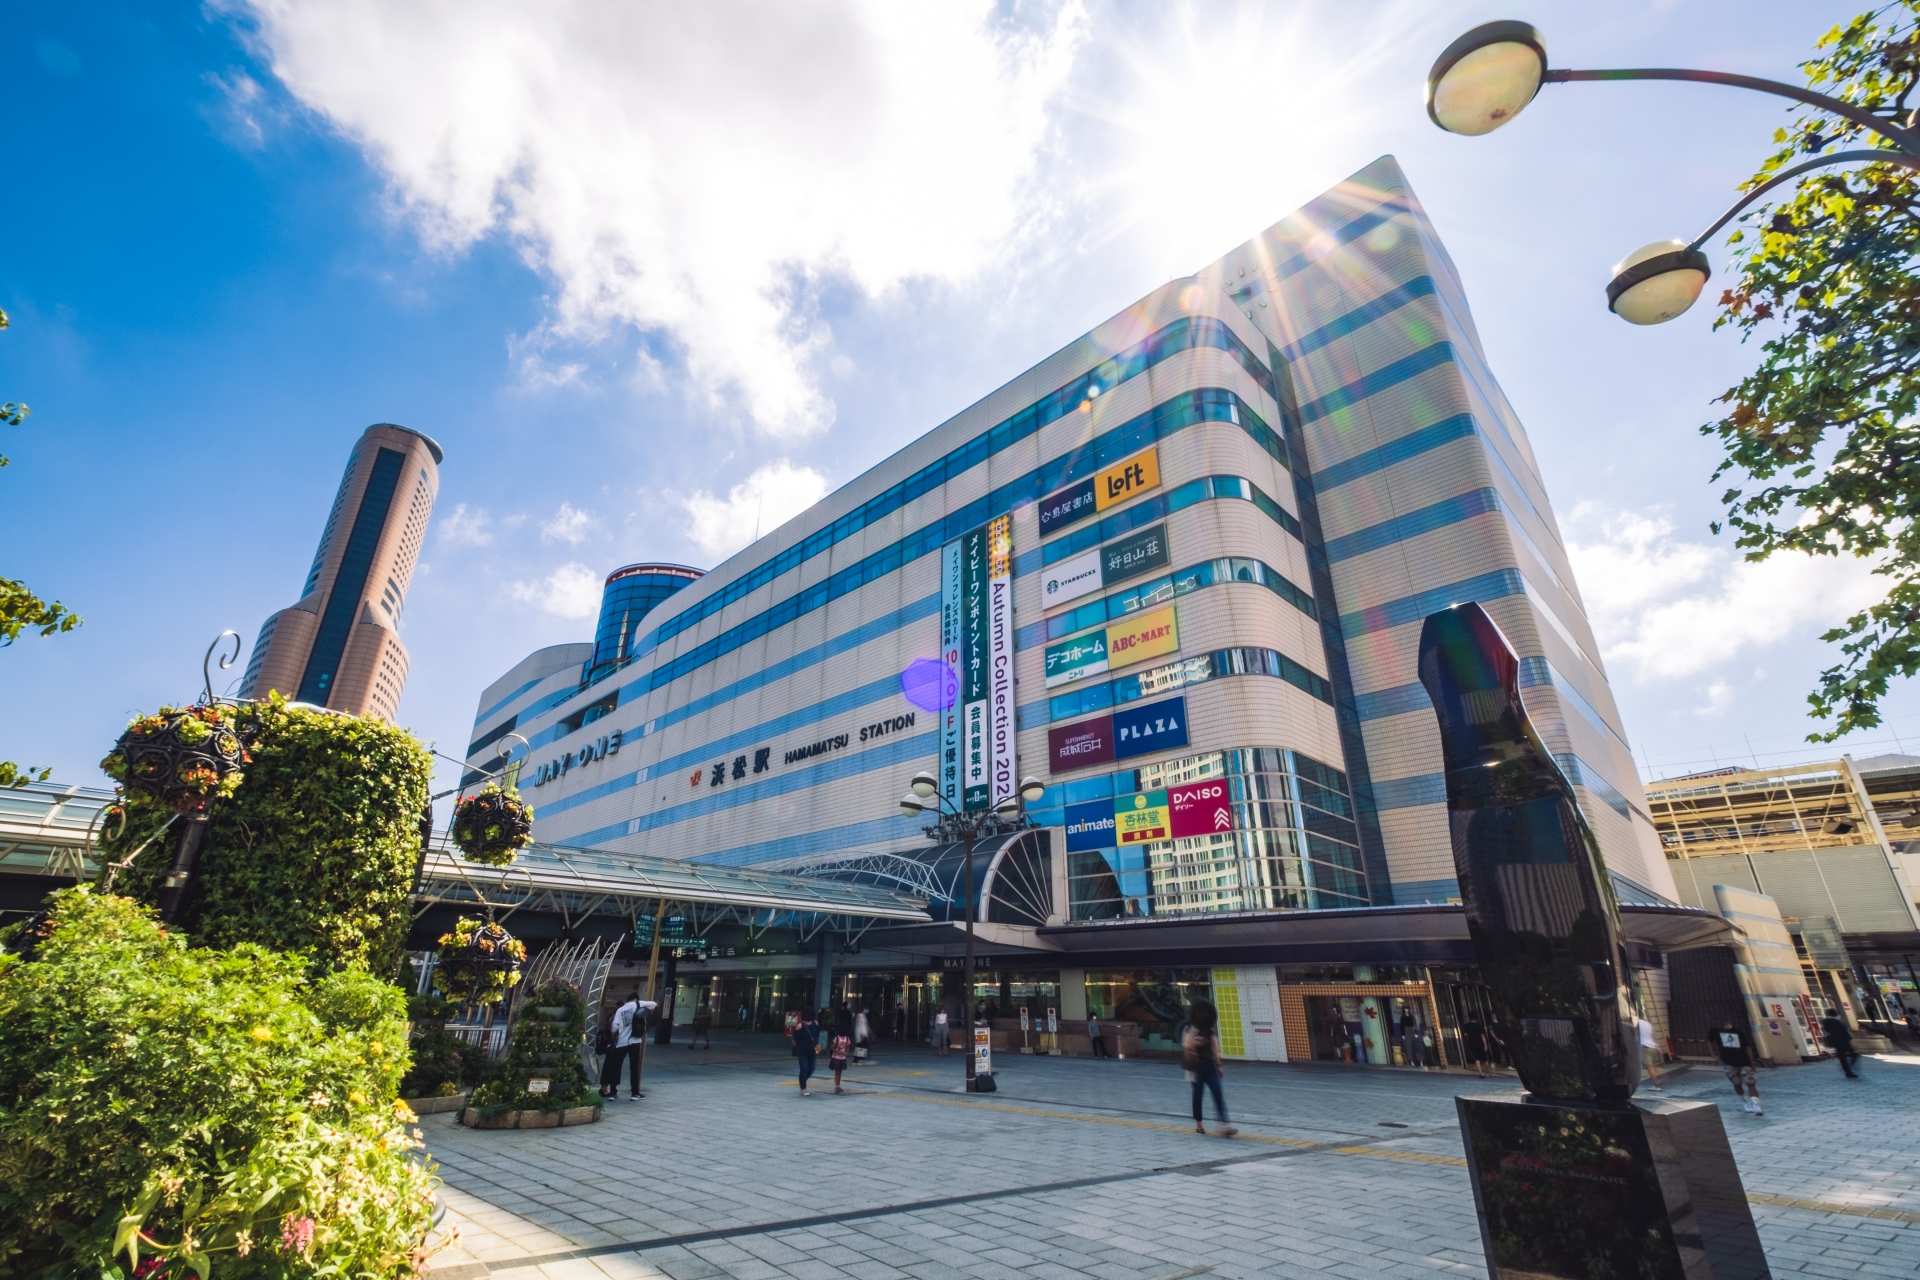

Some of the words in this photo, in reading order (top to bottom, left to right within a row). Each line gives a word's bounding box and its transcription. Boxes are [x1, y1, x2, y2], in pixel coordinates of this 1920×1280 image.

[1041, 491, 1093, 523] 谷島屋書店
[1108, 540, 1160, 570] 好日山荘
[1060, 568, 1097, 586] STARBUCKS
[993, 583, 1006, 652] Autumn
[1111, 624, 1171, 653] ABC-MART
[1046, 639, 1105, 670] デコホーム
[1068, 668, 1084, 680] ニトリ
[994, 655, 1009, 755] Collection
[1065, 732, 1095, 745] SUPERMARKET
[1120, 716, 1179, 742] PLAZA
[710, 747, 771, 787] 浜松駅
[784, 733, 849, 765] HAMAMATSU
[859, 712, 915, 742] STATION
[970, 706, 982, 781] 会員募集中
[1060, 738, 1102, 758] 成城石井
[534, 752, 572, 787] MAY
[579, 728, 623, 767] ONE
[996, 757, 1010, 802] 202
[1173, 786, 1222, 804] DAISO
[1174, 803, 1194, 811] ダイソー
[1067, 817, 1115, 835] animate
[1124, 809, 1160, 827] 杏林堂
[944, 959, 965, 968] MAY
[1569, 1169, 1629, 1186] NAGARE
